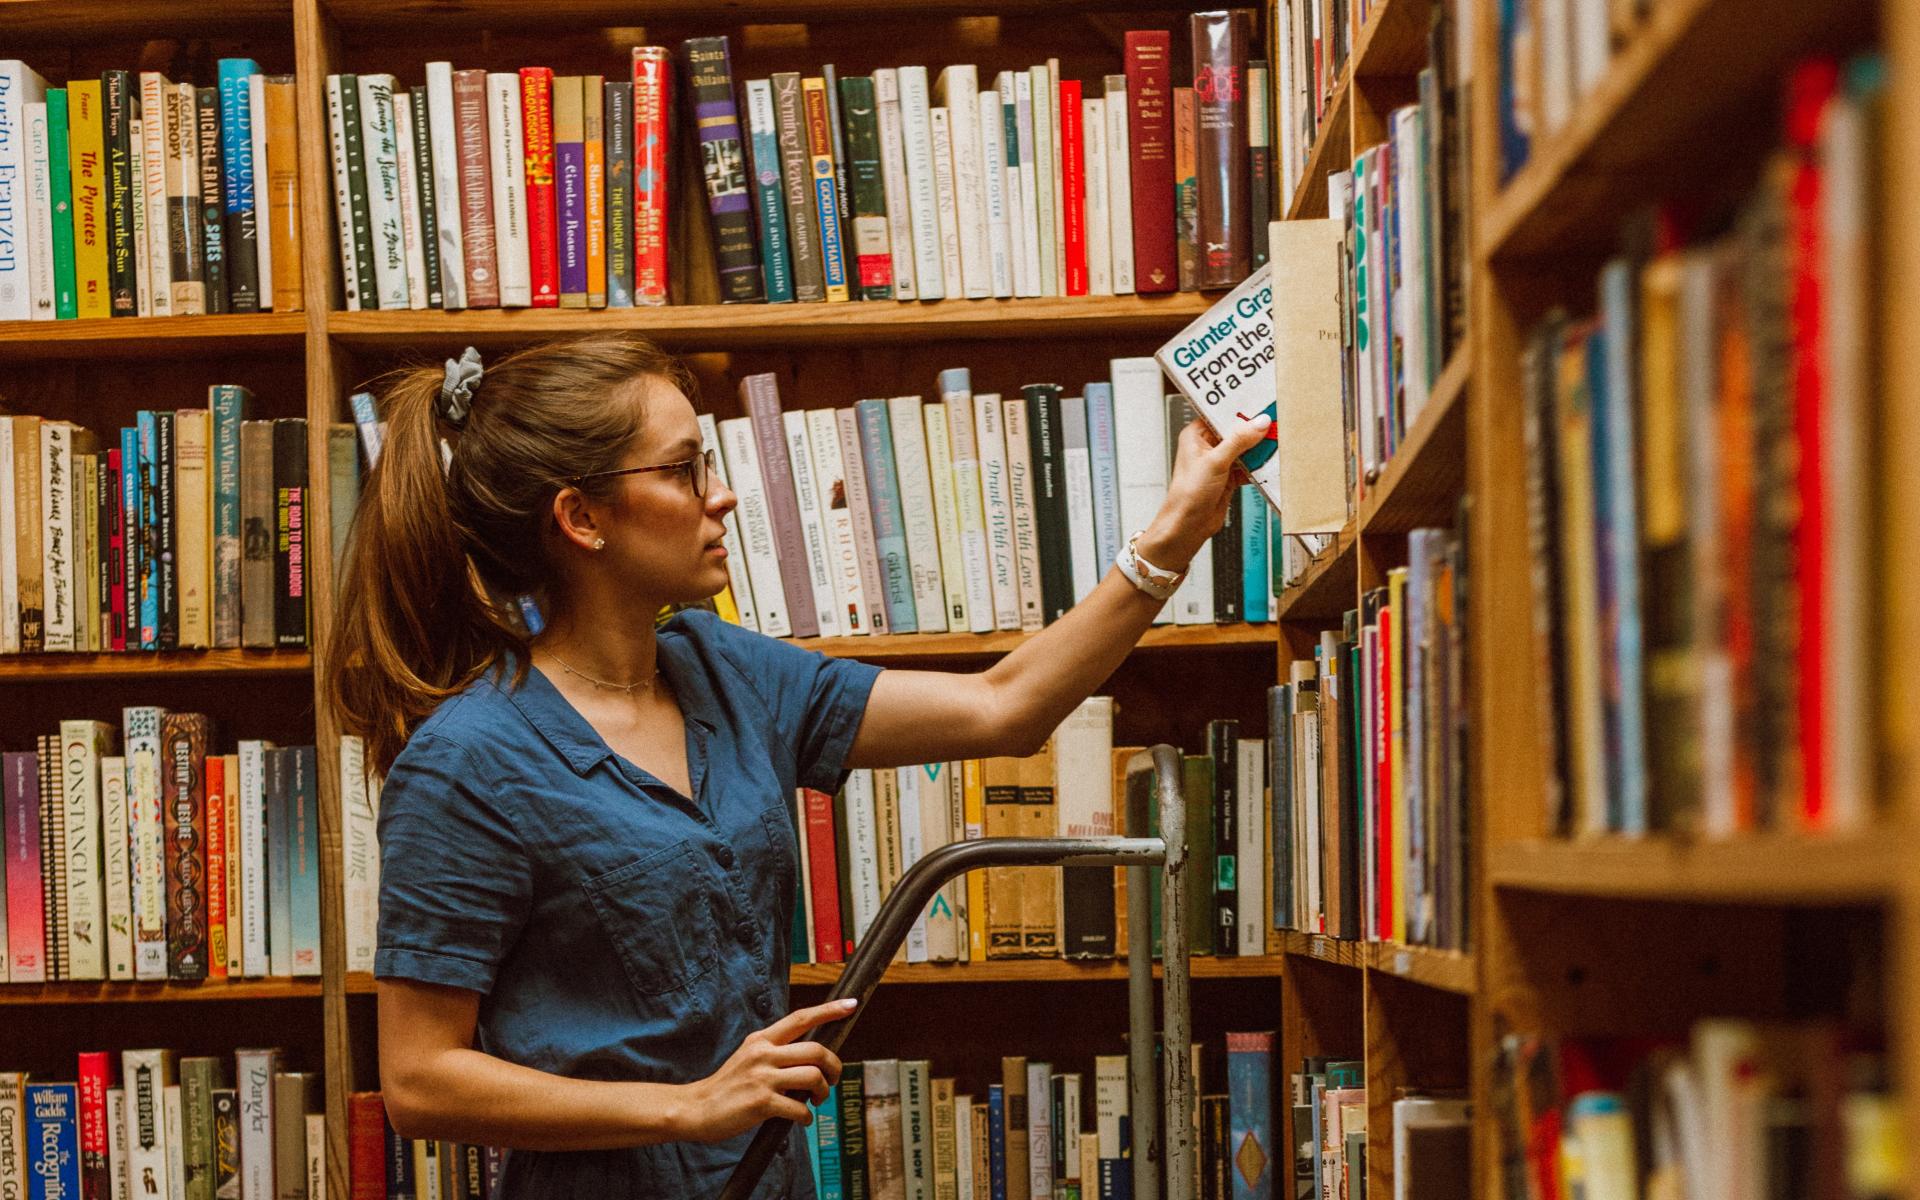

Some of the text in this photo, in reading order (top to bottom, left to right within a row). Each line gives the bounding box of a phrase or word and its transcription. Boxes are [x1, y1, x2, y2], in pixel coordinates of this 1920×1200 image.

[690, 50, 724, 62] Saints
[143, 79, 160, 150] MICHAEL
[369, 84, 395, 134] Elbowing
[460, 101, 480, 121] THE
[525, 76, 538, 152] CHROMOSOME
[538, 76, 549, 152] THE CALCUTTA
[636, 76, 648, 123] GHOSH
[166, 93, 181, 160] ENTROPY
[181, 94, 193, 158] AGAINST
[223, 77, 238, 208] CHARLES FRAZIER
[381, 137, 395, 155] the
[79, 93, 98, 247] Fraser The Pyrates
[109, 77, 129, 273] Michael Frayn A Landing on the Sun
[148, 153, 162, 198] FRAYN
[236, 76, 256, 240] COLD MOUNTAIN
[376, 158, 397, 202] Seducer
[612, 91, 624, 275] AMITAV GHOSH THE HUNGRY TIDE
[776, 77, 810, 261] Storming Heaven GIARDINA
[988, 142, 1001, 218] ELLEN FOSTER
[131, 152, 144, 232] THE TIN MEN
[200, 108, 221, 262] MICHAEL FRAYN SPIES
[334, 133, 342, 175] BOOK
[341, 221, 353, 283] NIGHTS
[344, 88, 370, 300] SYLVIE GERMAIN
[565, 165, 576, 207] Circle
[589, 164, 600, 215] Shadow
[819, 180, 835, 215] GOOD
[0, 165, 18, 272] Franzen
[566, 220, 578, 267] Reason
[590, 219, 601, 256] Lines
[636, 200, 650, 255] Poppies
[648, 208, 661, 231] Sea
[824, 216, 838, 246] KING
[827, 246, 841, 282] HARRY
[1173, 283, 1273, 368] Günter Gra
[1186, 322, 1271, 390] From the
[1205, 335, 1275, 406] of a Sna
[215, 389, 235, 416] Rip
[220, 418, 235, 443] Van
[1038, 395, 1054, 498] ELLEN GILCHRIST Starcarbon
[220, 444, 237, 494] Winkle
[983, 401, 1011, 587] Gilchrist Drunk With Love
[1096, 394, 1116, 565] GILCHRIST A DANGEROUS AGE
[126, 472, 135, 525] COLUMBUS
[289, 487, 301, 503] THE
[289, 505, 301, 528] ROAD
[1007, 403, 1035, 588] Gilchrist Drunk With Love
[220, 503, 232, 543] Sanford
[289, 530, 301, 542] TO
[126, 527, 136, 588] SLAUGHTERS
[835, 518, 859, 594] RHODA
[885, 551, 903, 605] Gilchrist
[913, 563, 926, 599] Gilchrist
[926, 569, 937, 591] Ellen
[127, 591, 136, 629] BRAVES
[175, 741, 190, 784] DESTINY
[67, 741, 90, 890] CONSTANCIA
[884, 783, 892, 807] CONEY
[953, 776, 961, 829] ELPENOR
[1223, 789, 1232, 840] The Odd Women
[106, 778, 124, 887] CONSTANCIA
[177, 803, 193, 840] DESIRE
[243, 750, 256, 944] The Crystal Frontier CARLOS FUENTES
[143, 831, 153, 871] CARLOS
[179, 849, 192, 887] CARLOS
[208, 794, 224, 917] CARLOS FUENTES
[886, 836, 895, 877] QUICKSTEP
[145, 875, 156, 923] FUENTES
[181, 889, 193, 932] FUENTES
[213, 929, 226, 963] USED
[33, 1089, 68, 1105] William
[35, 1106, 67, 1119] Gaddis
[114, 1096, 123, 1121] Peter
[137, 1072, 154, 1144] METROPOLIS
[243, 1065, 270, 1134] Dangler
[842, 1079, 862, 1096] THE
[0, 1106, 16, 1176] Carpenter's
[83, 1075, 94, 1169] ARE SAFEST
[92, 1075, 105, 1169] JUST WHEN WE
[117, 1123, 125, 1151] Gadol
[908, 1069, 923, 1179] YEARS FROM NOW
[1032, 1124, 1052, 1162] FIRST
[60, 1151, 70, 1166] the
[118, 1160, 126, 1178] THE
[467, 1146, 481, 1197] CEMENT
[1033, 1165, 1054, 1188] FIG
